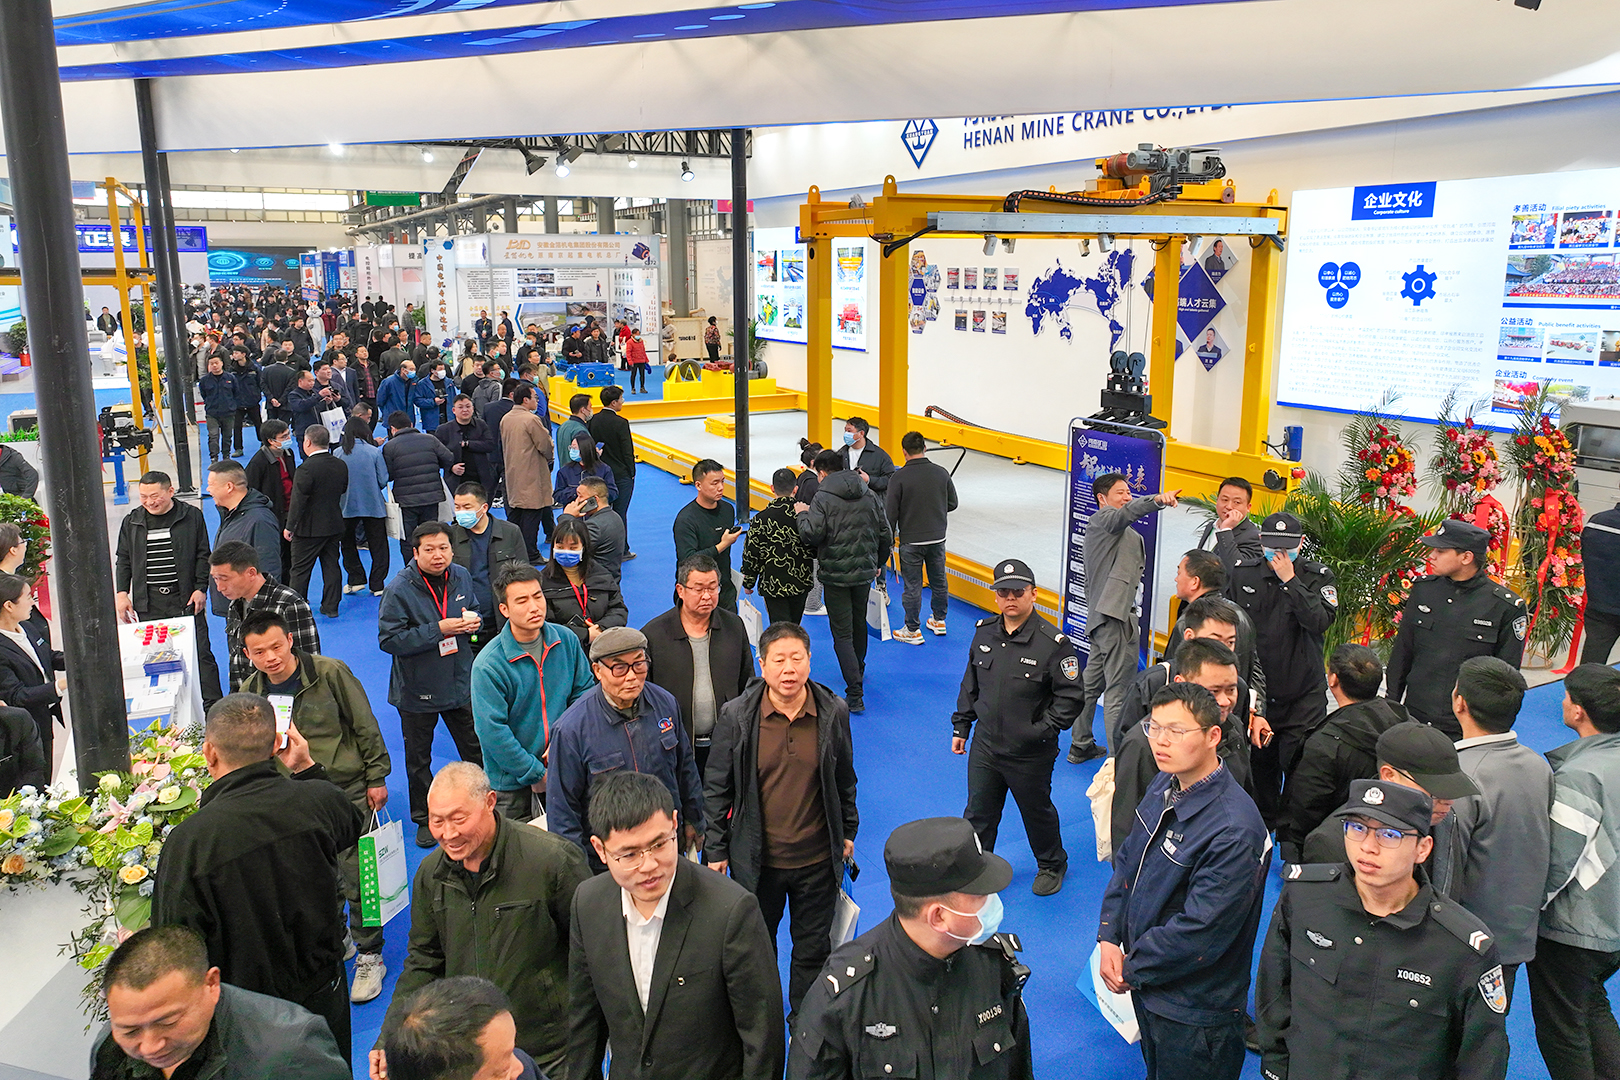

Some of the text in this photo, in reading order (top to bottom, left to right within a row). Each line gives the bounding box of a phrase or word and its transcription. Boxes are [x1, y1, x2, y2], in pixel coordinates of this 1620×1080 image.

[964, 124, 1014, 149] HENAN
[1021, 116, 1064, 140] MINE
[1072, 109, 1135, 132] CRANE
[1363, 190, 1423, 209] 企业文化
[1513, 203, 1547, 213] 孝善活动
[1177, 297, 1217, 309] 端人才云集
[1500, 317, 1533, 326] 公益活动
[1495, 369, 1528, 379] 企业活动
[1397, 968, 1432, 986] X00652
[977, 1004, 1003, 1024] X00136
